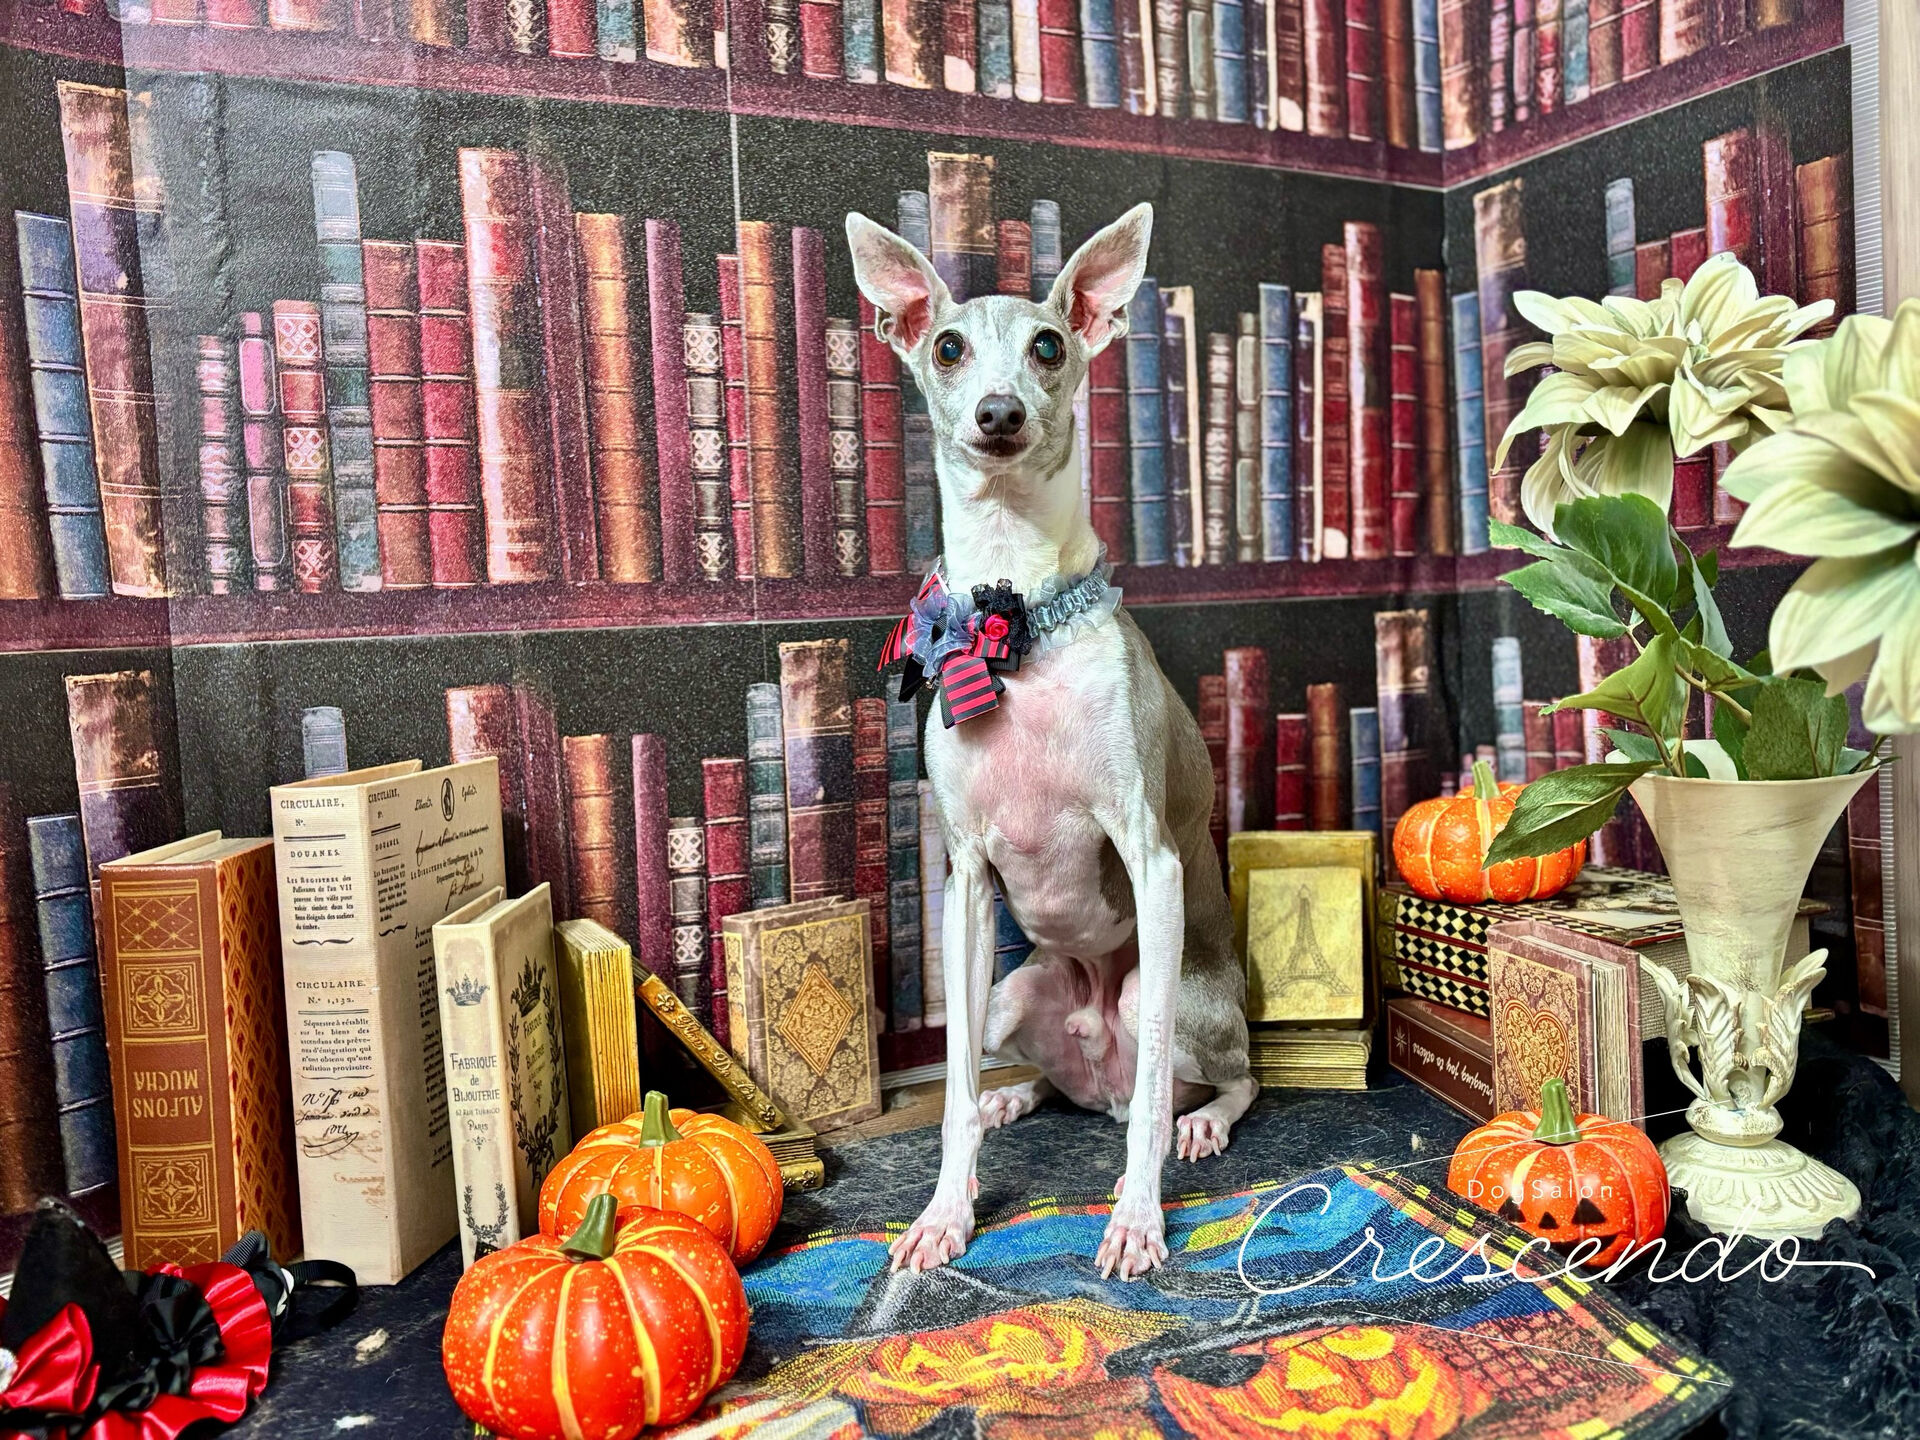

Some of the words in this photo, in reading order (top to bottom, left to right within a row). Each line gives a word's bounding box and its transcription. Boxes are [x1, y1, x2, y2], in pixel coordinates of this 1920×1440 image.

[449, 1053, 497, 1071] FABRIQUE
[1445, 1056, 1460, 1080] joy
[133, 1069, 199, 1092] MUCHA
[470, 1074, 480, 1086] de
[452, 1087, 501, 1102] BIJOUTERIE
[132, 1095, 203, 1118] ALFONS
